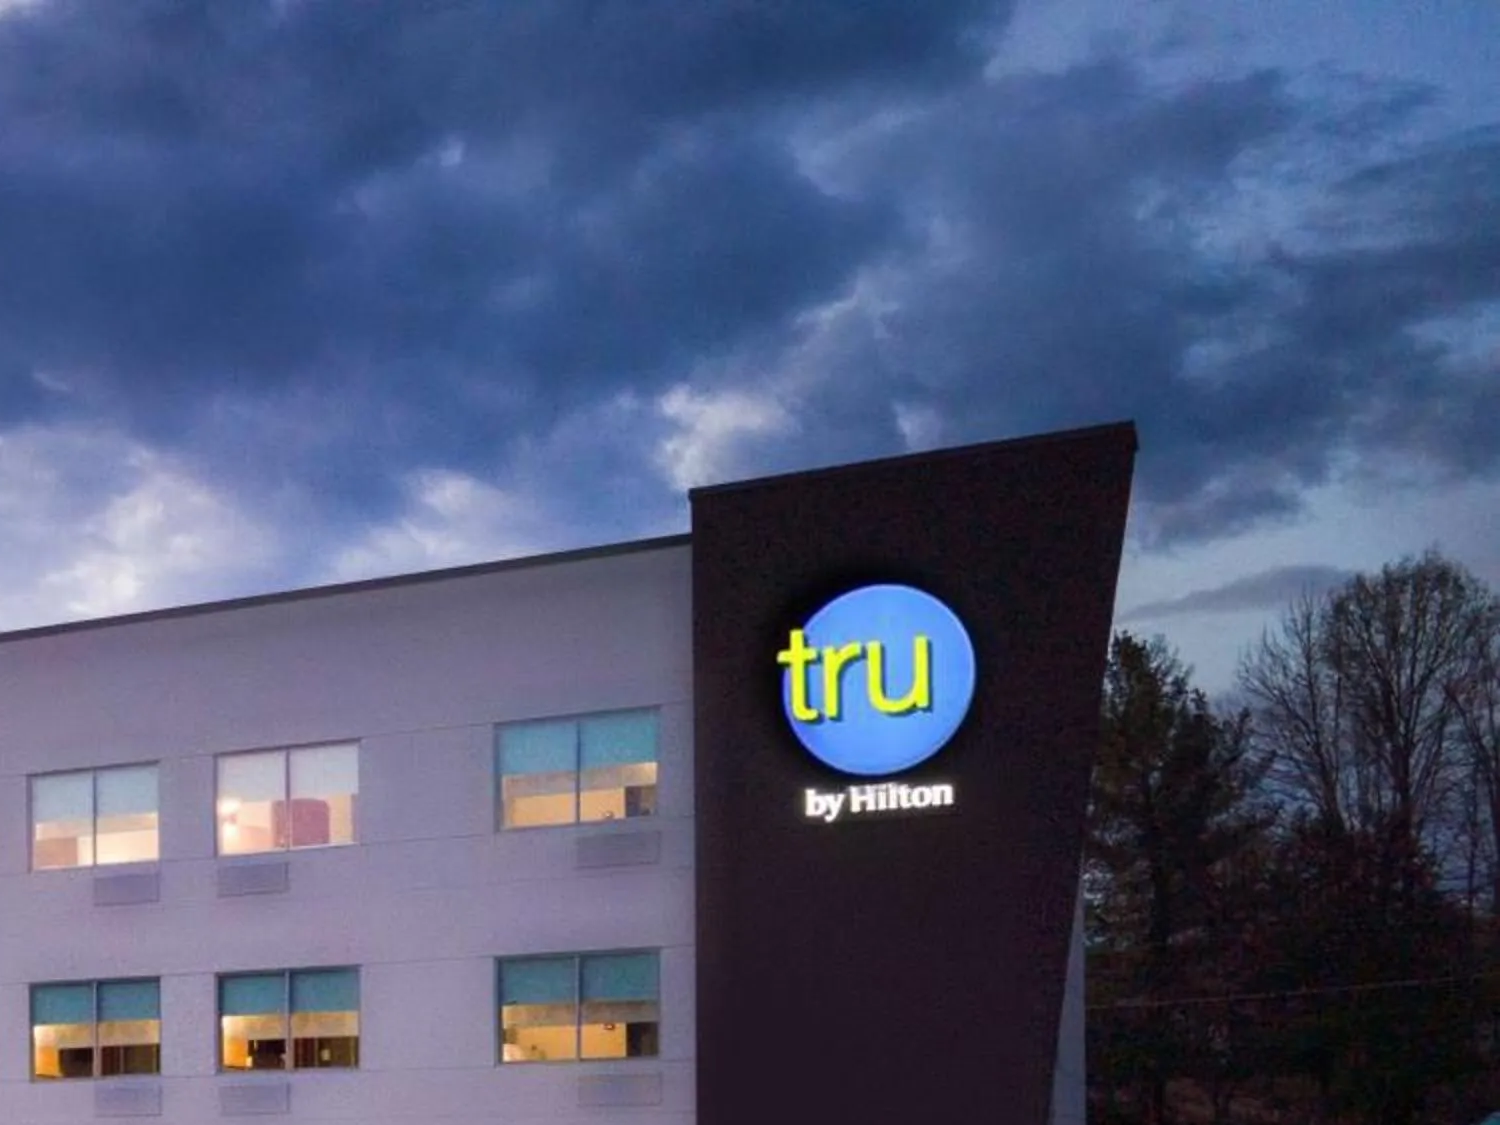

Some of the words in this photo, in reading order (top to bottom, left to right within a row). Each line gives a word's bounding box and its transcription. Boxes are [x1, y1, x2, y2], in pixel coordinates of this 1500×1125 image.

[777, 629, 930, 722] tru
[805, 788, 845, 822] by
[849, 782, 954, 813] Hilton
